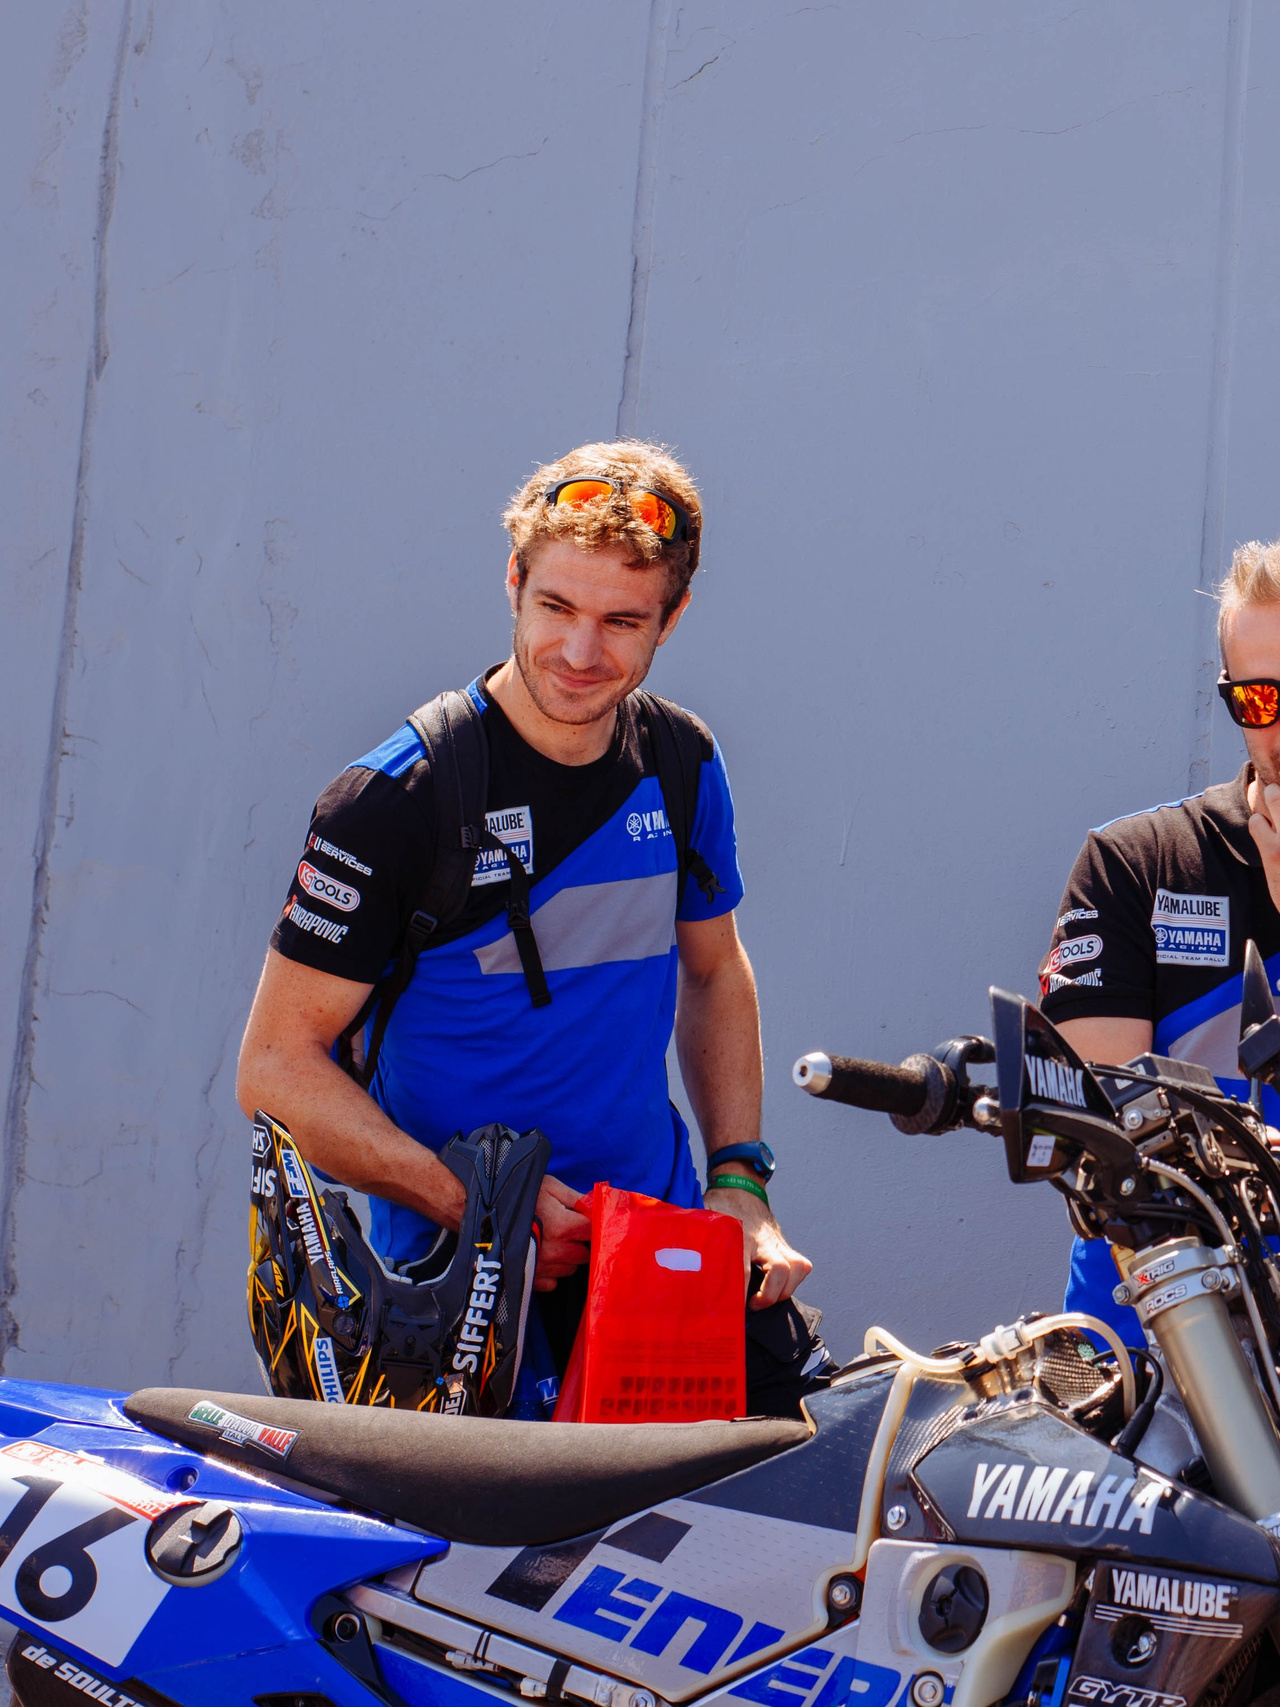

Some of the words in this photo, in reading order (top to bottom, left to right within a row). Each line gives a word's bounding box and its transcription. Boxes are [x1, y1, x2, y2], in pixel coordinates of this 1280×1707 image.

[300, 865, 318, 889] KS
[312, 874, 354, 906] TOOLS
[320, 843, 374, 877] SERVICES
[1157, 894, 1221, 918] YAMALUBE
[1157, 943, 1219, 953] RACING
[1168, 929, 1222, 947] YAMAHA
[1025, 1053, 1088, 1109] YAMAHA
[296, 1201, 325, 1266] YAMAHA
[453, 1254, 502, 1374] SIFFERT
[190, 1406, 226, 1426] SELLE
[258, 1427, 295, 1453] VALLE
[966, 1462, 1165, 1535] YAMAHA
[0, 1475, 139, 1622] 16
[1111, 1568, 1232, 1620] YAMALUBE
[21, 1645, 57, 1669] de
[53, 1661, 147, 1707] SOULT
